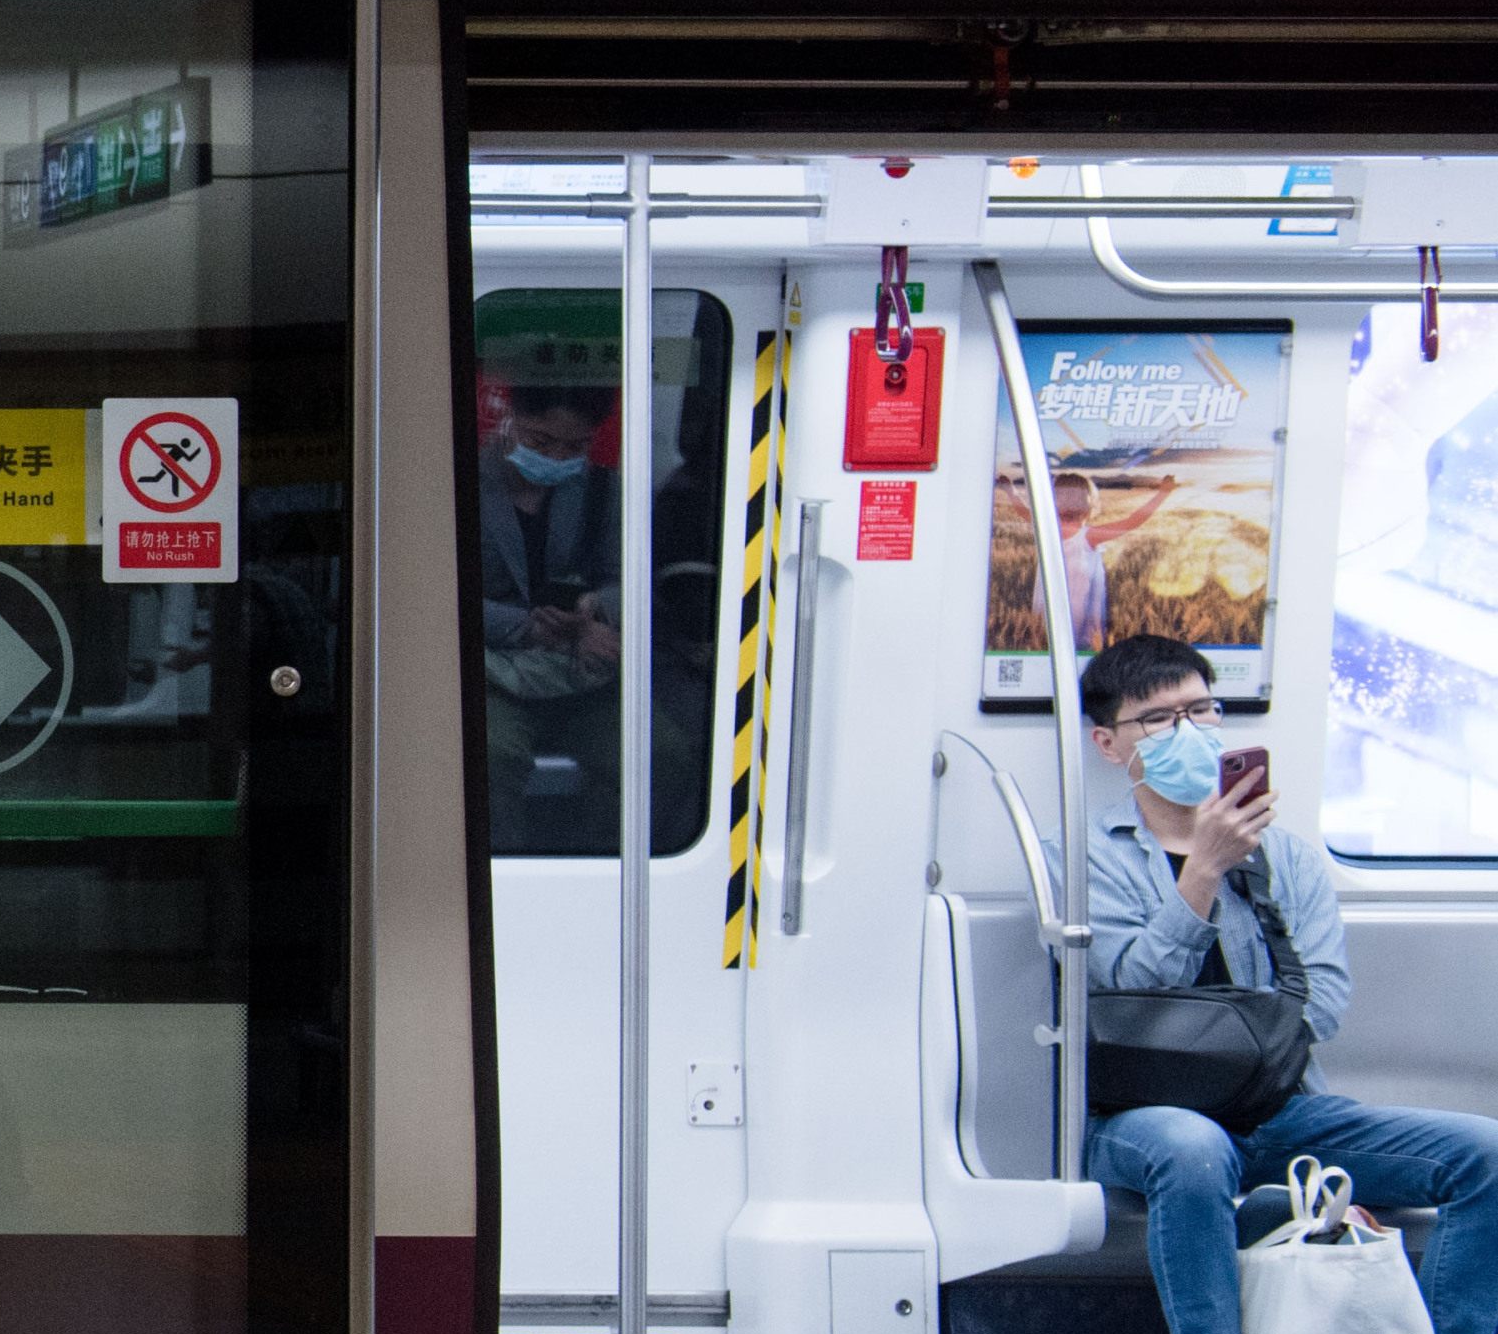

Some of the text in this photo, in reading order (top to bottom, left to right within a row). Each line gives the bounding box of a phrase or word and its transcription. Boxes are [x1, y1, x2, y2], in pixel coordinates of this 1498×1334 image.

[1050, 351, 1183, 381] Follow me
[1038, 382, 1243, 428] 梦想新天地
[3, 490, 55, 507] Hand
[125, 530, 216, 549] 请勿抢上抢下
[146, 550, 195, 562] No Rush
